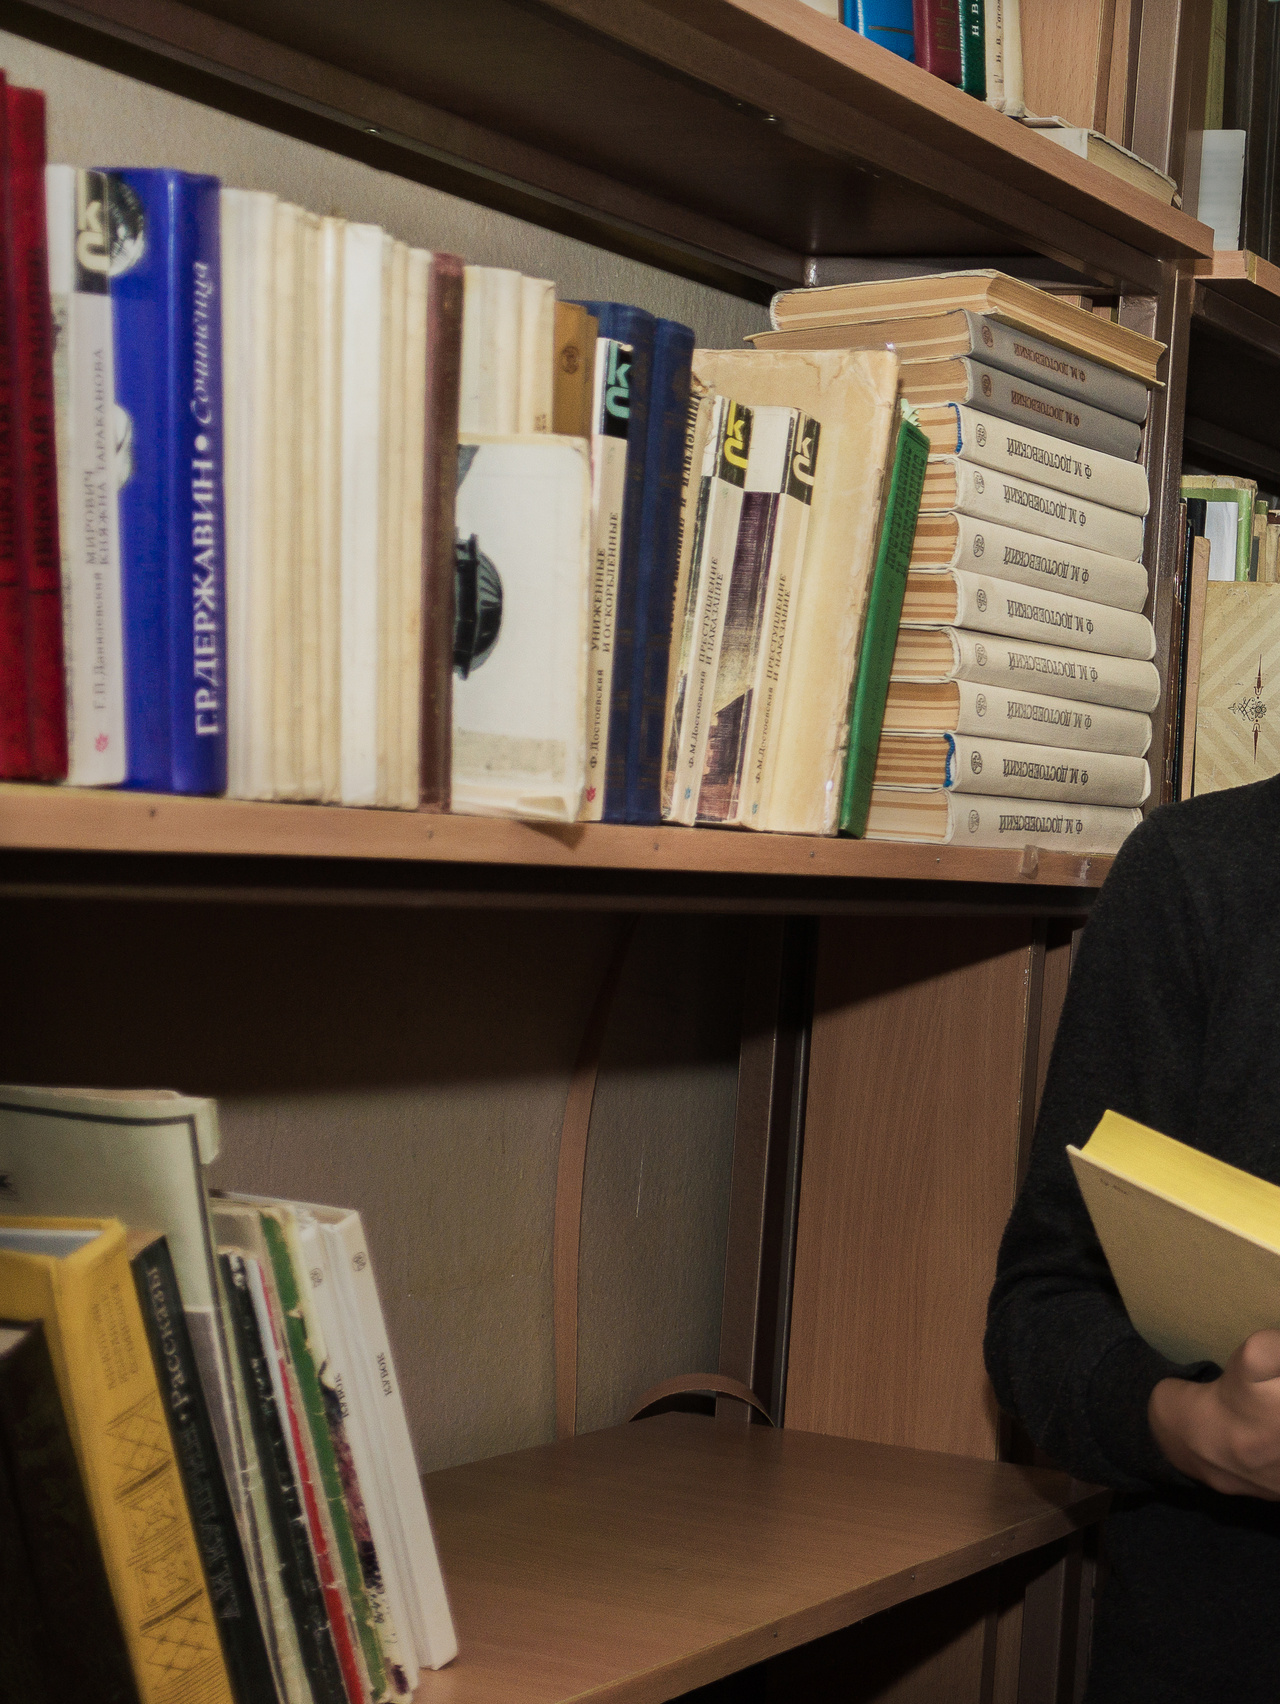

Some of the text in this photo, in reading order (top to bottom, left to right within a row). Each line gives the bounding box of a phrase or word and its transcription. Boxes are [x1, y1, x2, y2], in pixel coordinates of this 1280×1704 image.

[1013, 343, 1069, 376] ДОСТОЕВСКИЙ
[1011, 390, 1065, 421] ДОСТОЕВСКИЙ
[1006, 437, 1072, 473] ДОСТОЕВСКИЙ
[1002, 484, 1067, 520] ДОСТОЕВСКИЙ
[603, 511, 619, 640] ОСКОРБЛЕННЫЕ
[1003, 546, 1070, 579] ДОСТОЕВСКИЙ
[591, 548, 606, 651] УНИЖЕННЫЕ
[699, 556, 719, 663] ПРЕСТУПЛЕНИЕ
[709, 572, 724, 654] НАКАЗАНИЕ
[1007, 599, 1074, 630] ДОСТОЕВСКИЙ
[766, 574, 787, 680] ПРЕСТУПЛЕНИЕ
[776, 589, 791, 670] НАКАЗАНИЕ
[1007, 651, 1076, 678] ДОСТОЕВСКИЙ
[1007, 701, 1072, 726] ДОСТОЕВСКИЙ
[1002, 759, 1069, 783] ДОСТОЕВСКИЙ
[998, 814, 1064, 834] ДОСТОЕВСКИЙ
[147, 1267, 190, 1412] Рассказы
